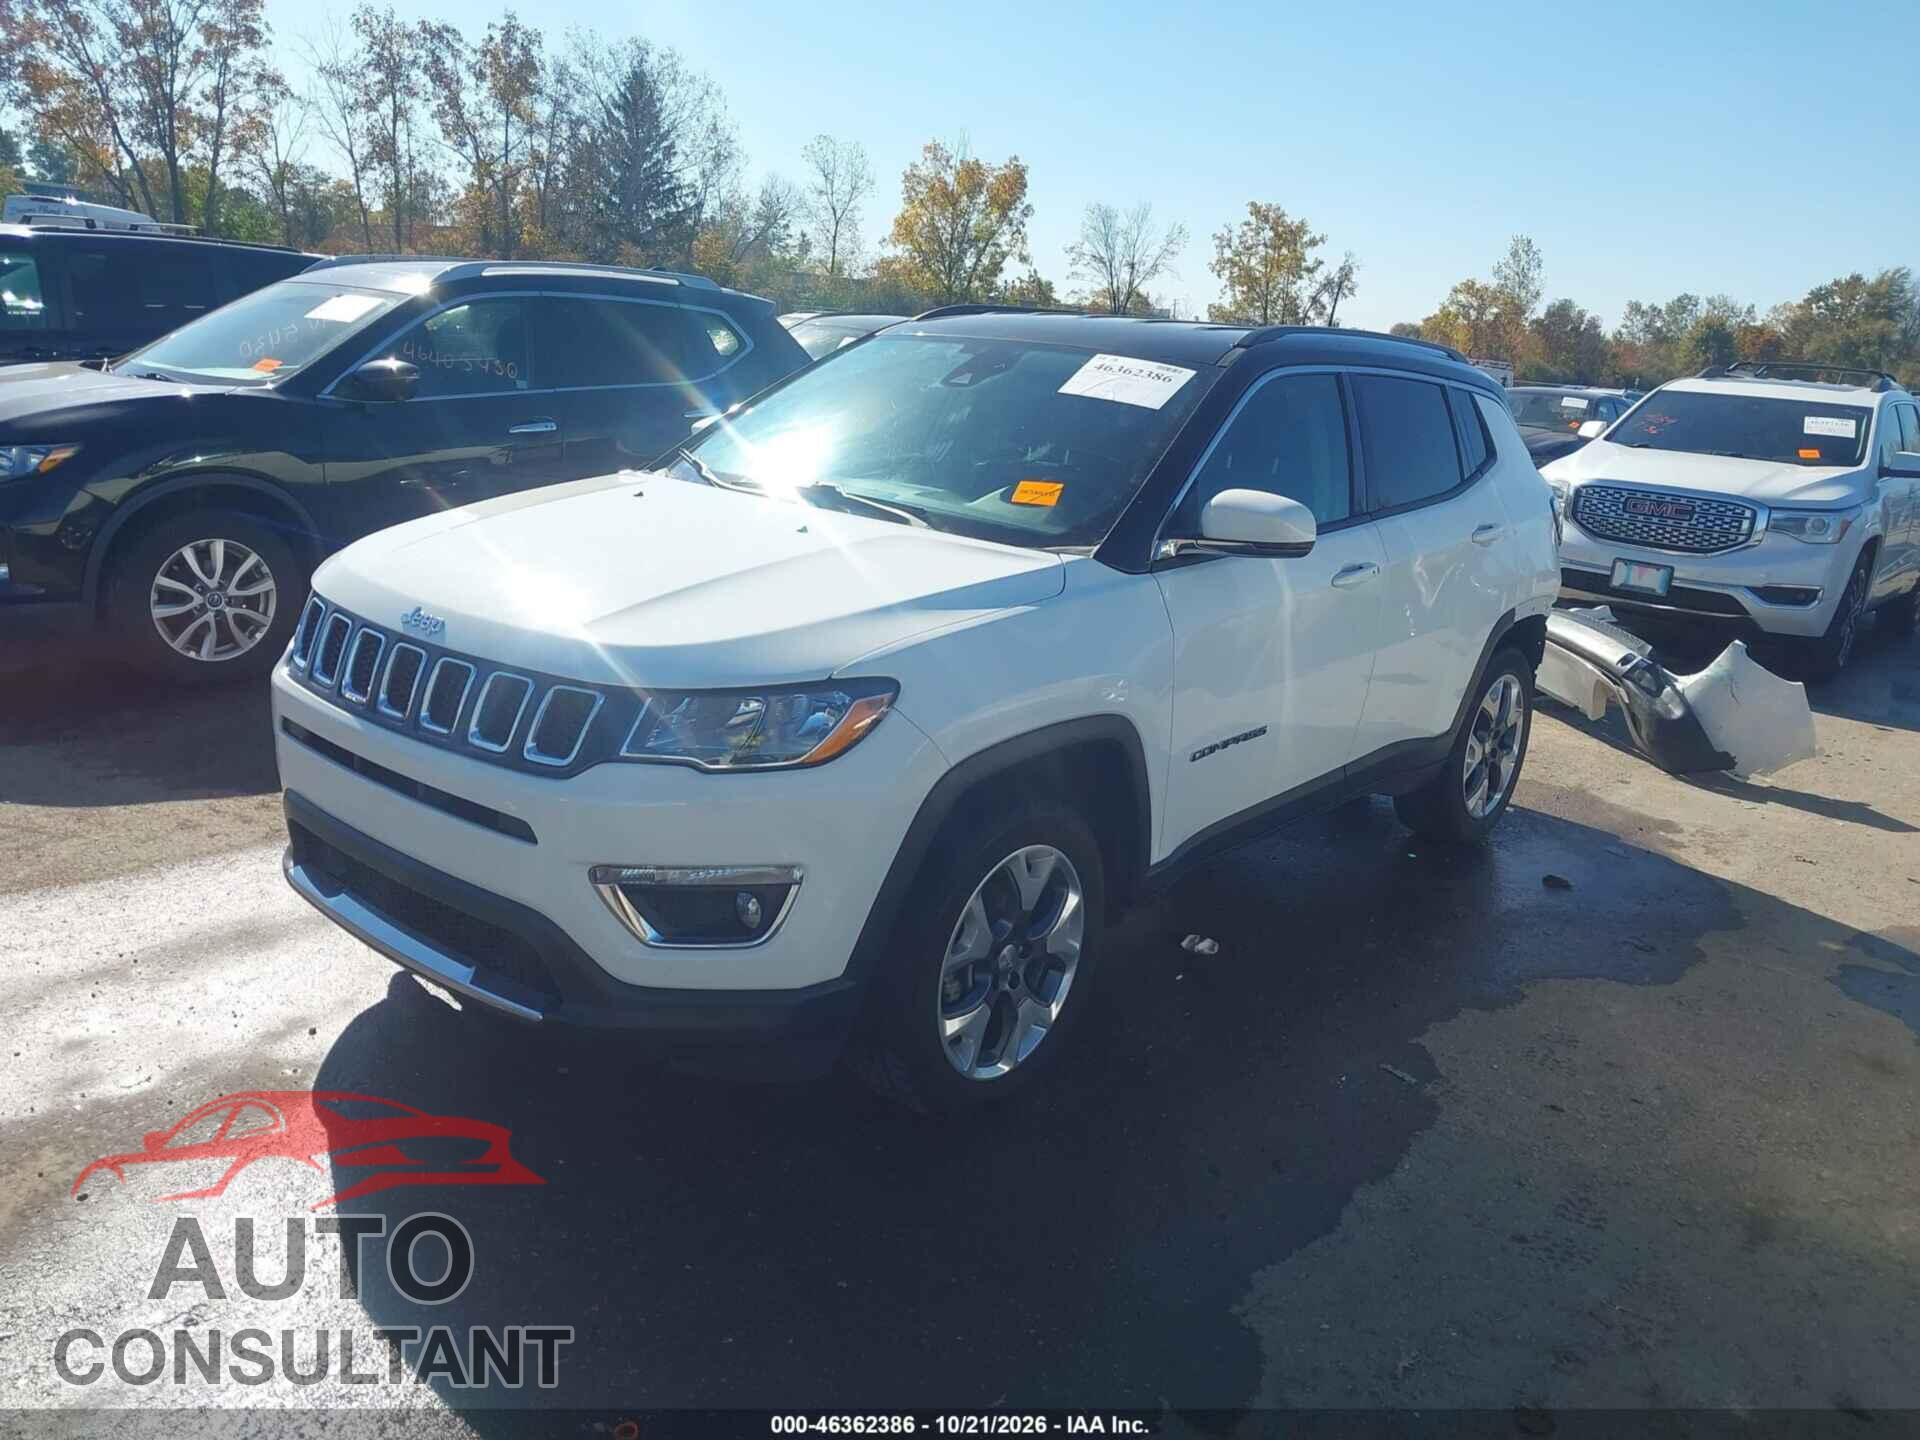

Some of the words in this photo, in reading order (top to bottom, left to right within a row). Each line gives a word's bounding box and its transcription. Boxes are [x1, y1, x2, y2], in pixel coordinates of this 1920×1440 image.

[1094, 363, 1173, 383] 46362386
[1626, 499, 1693, 521] GMC
[401, 606, 446, 637] Jeep
[1189, 725, 1268, 762] COMPASS
